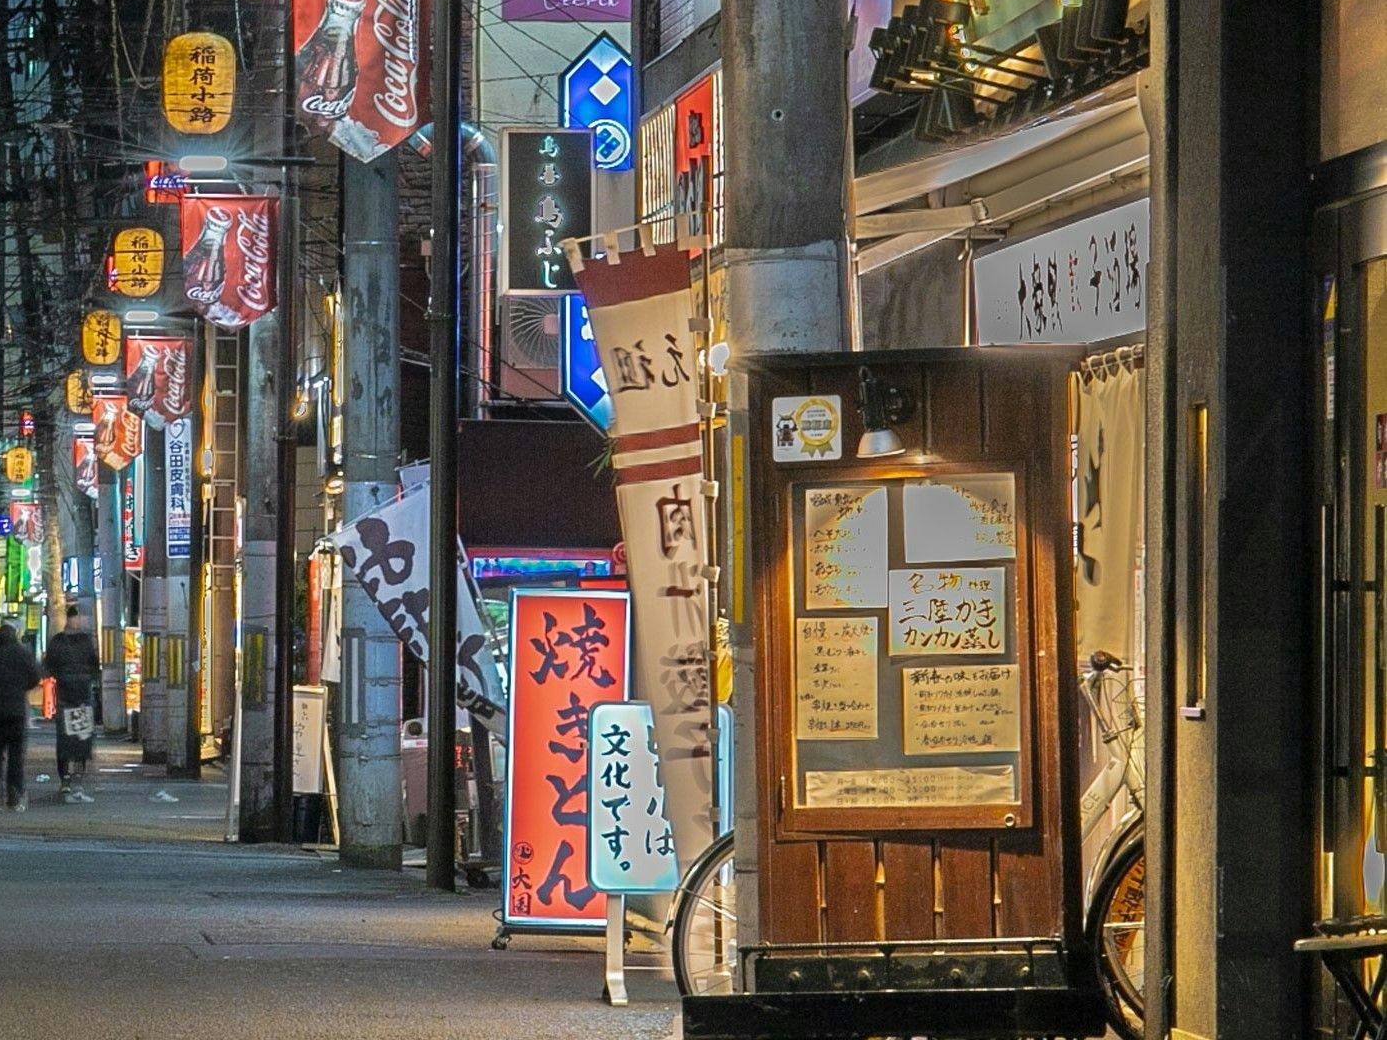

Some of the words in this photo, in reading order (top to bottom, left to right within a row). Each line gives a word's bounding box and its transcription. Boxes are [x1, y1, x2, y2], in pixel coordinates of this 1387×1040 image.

[189, 46, 216, 124] 稲荷小路
[131, 235, 150, 289] 稲荷小路
[237, 208, 269, 311] Coca-Cola
[163, 346, 186, 415] Coca-Cola
[898, 598, 997, 628] 三陸かき
[903, 626, 1001, 649] カンカン蒸し
[601, 724, 631, 871] 文化です。
